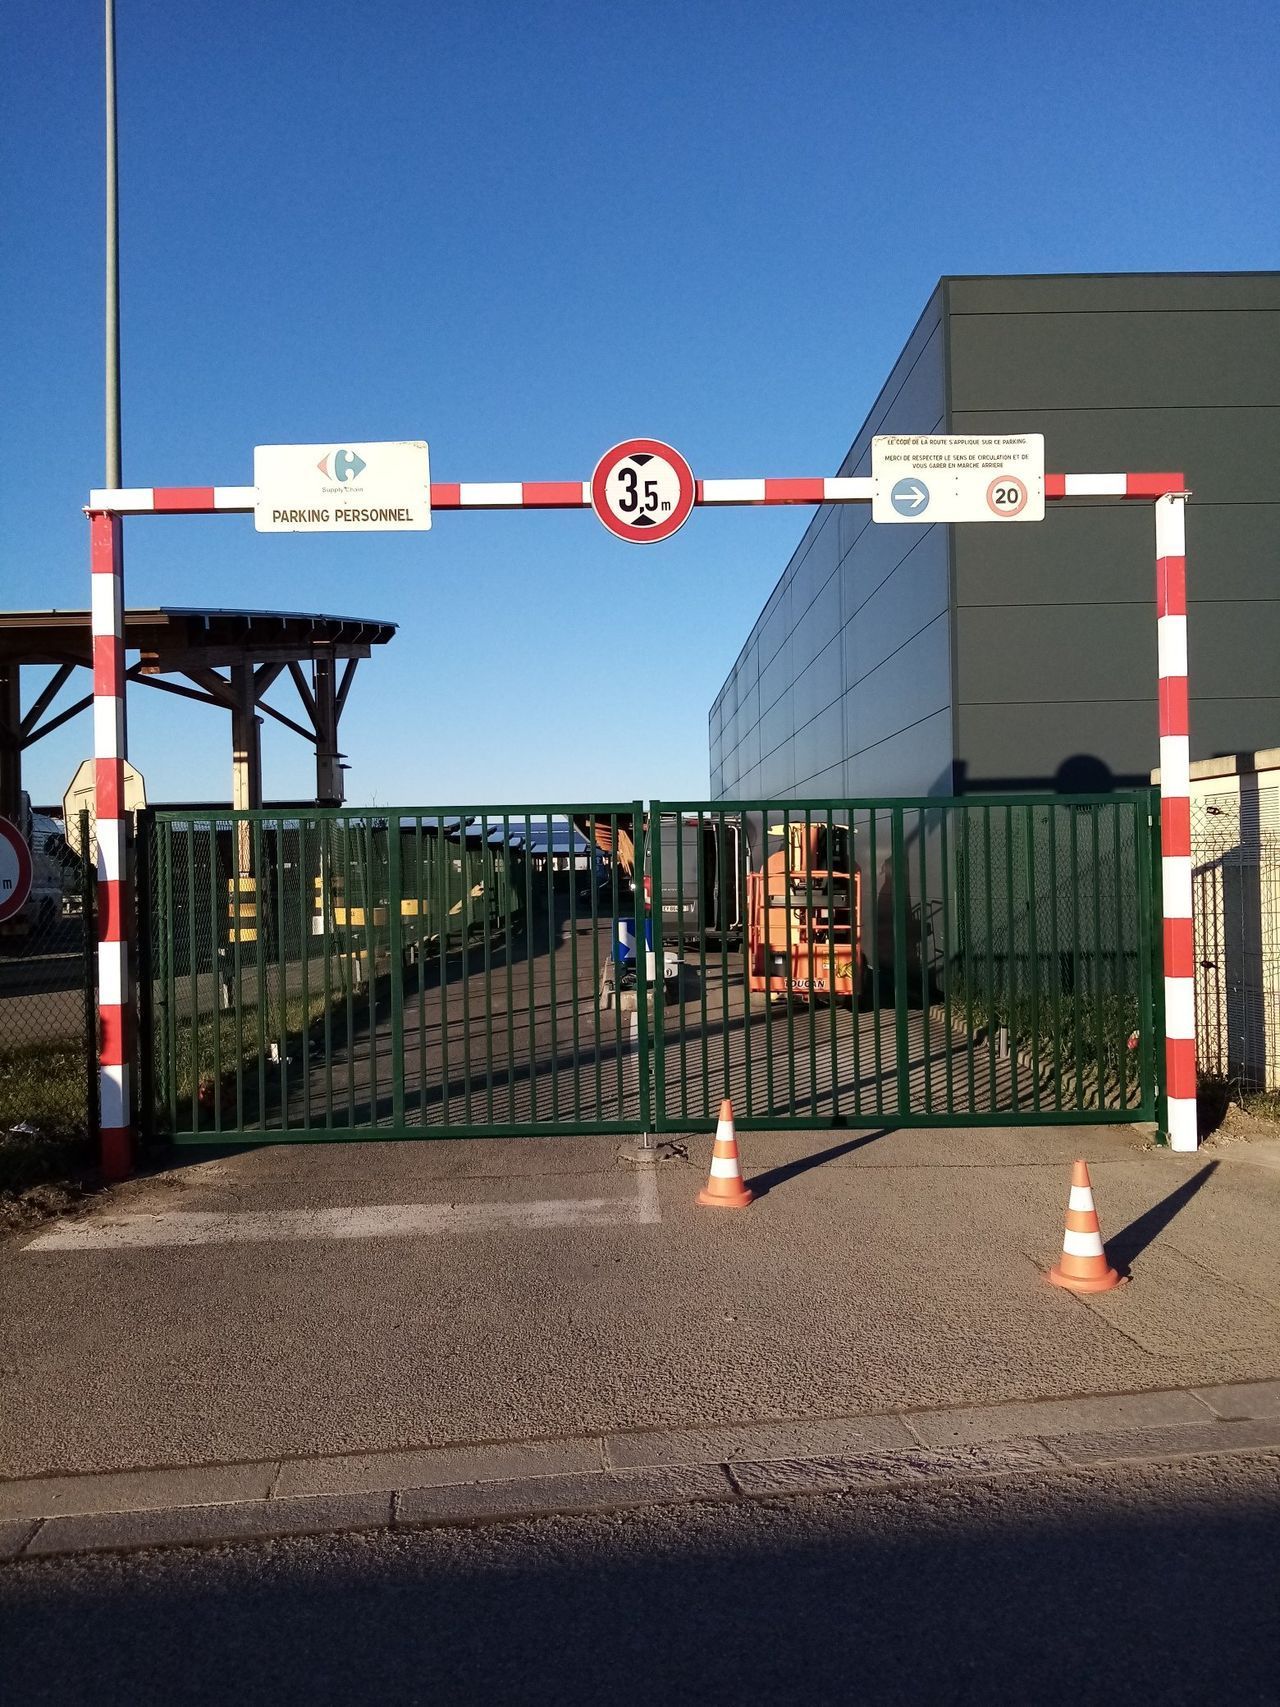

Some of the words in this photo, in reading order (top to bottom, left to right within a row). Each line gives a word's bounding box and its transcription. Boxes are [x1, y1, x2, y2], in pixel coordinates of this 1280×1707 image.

[996, 488, 1018, 504] 20
[272, 510, 330, 522] PARKING
[336, 508, 414, 522] PERSONNEL
